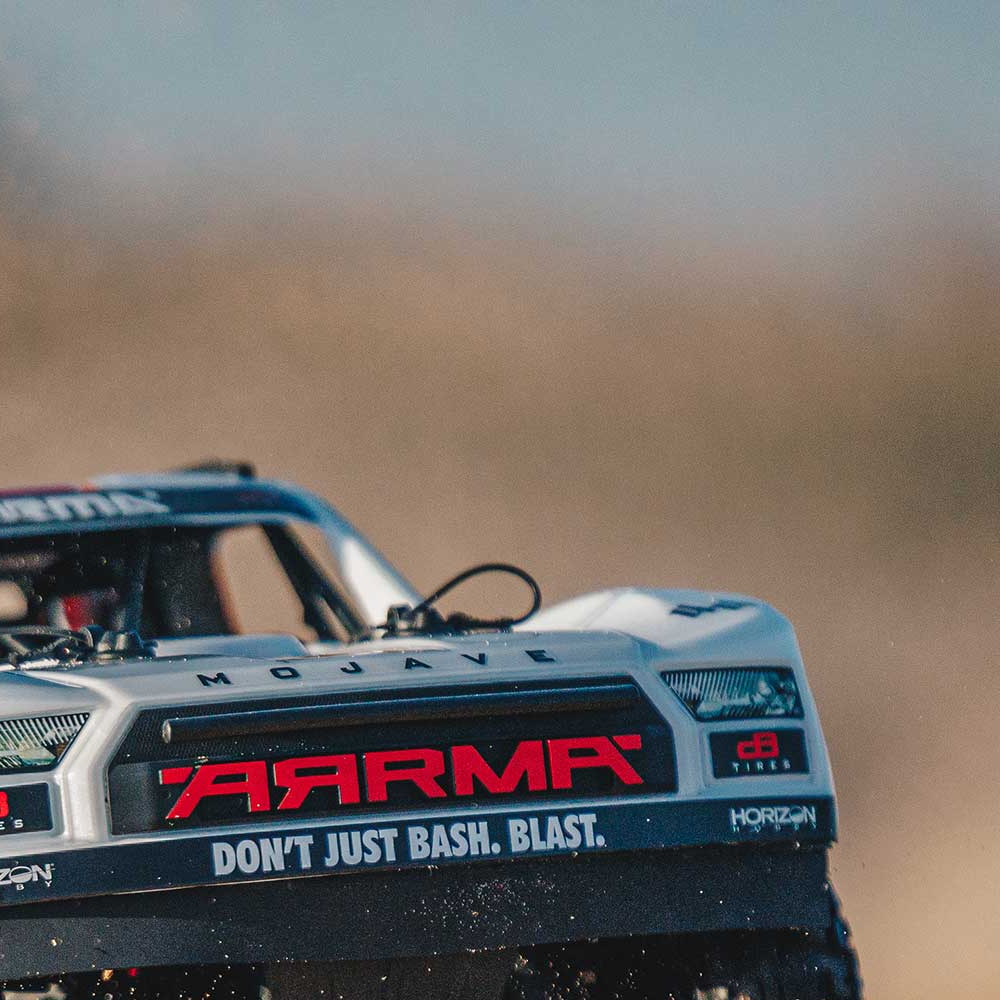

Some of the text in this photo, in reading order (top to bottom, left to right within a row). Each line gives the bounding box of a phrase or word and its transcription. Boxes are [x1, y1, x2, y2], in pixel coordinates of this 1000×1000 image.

[196, 649, 557, 687] MOJAVE
[160, 734, 644, 819] ARRMA
[732, 759, 791, 773] TIRES
[730, 805, 817, 825] HORIZON
[212, 813, 606, 876] DON'T JUST BASH. BLAST.
